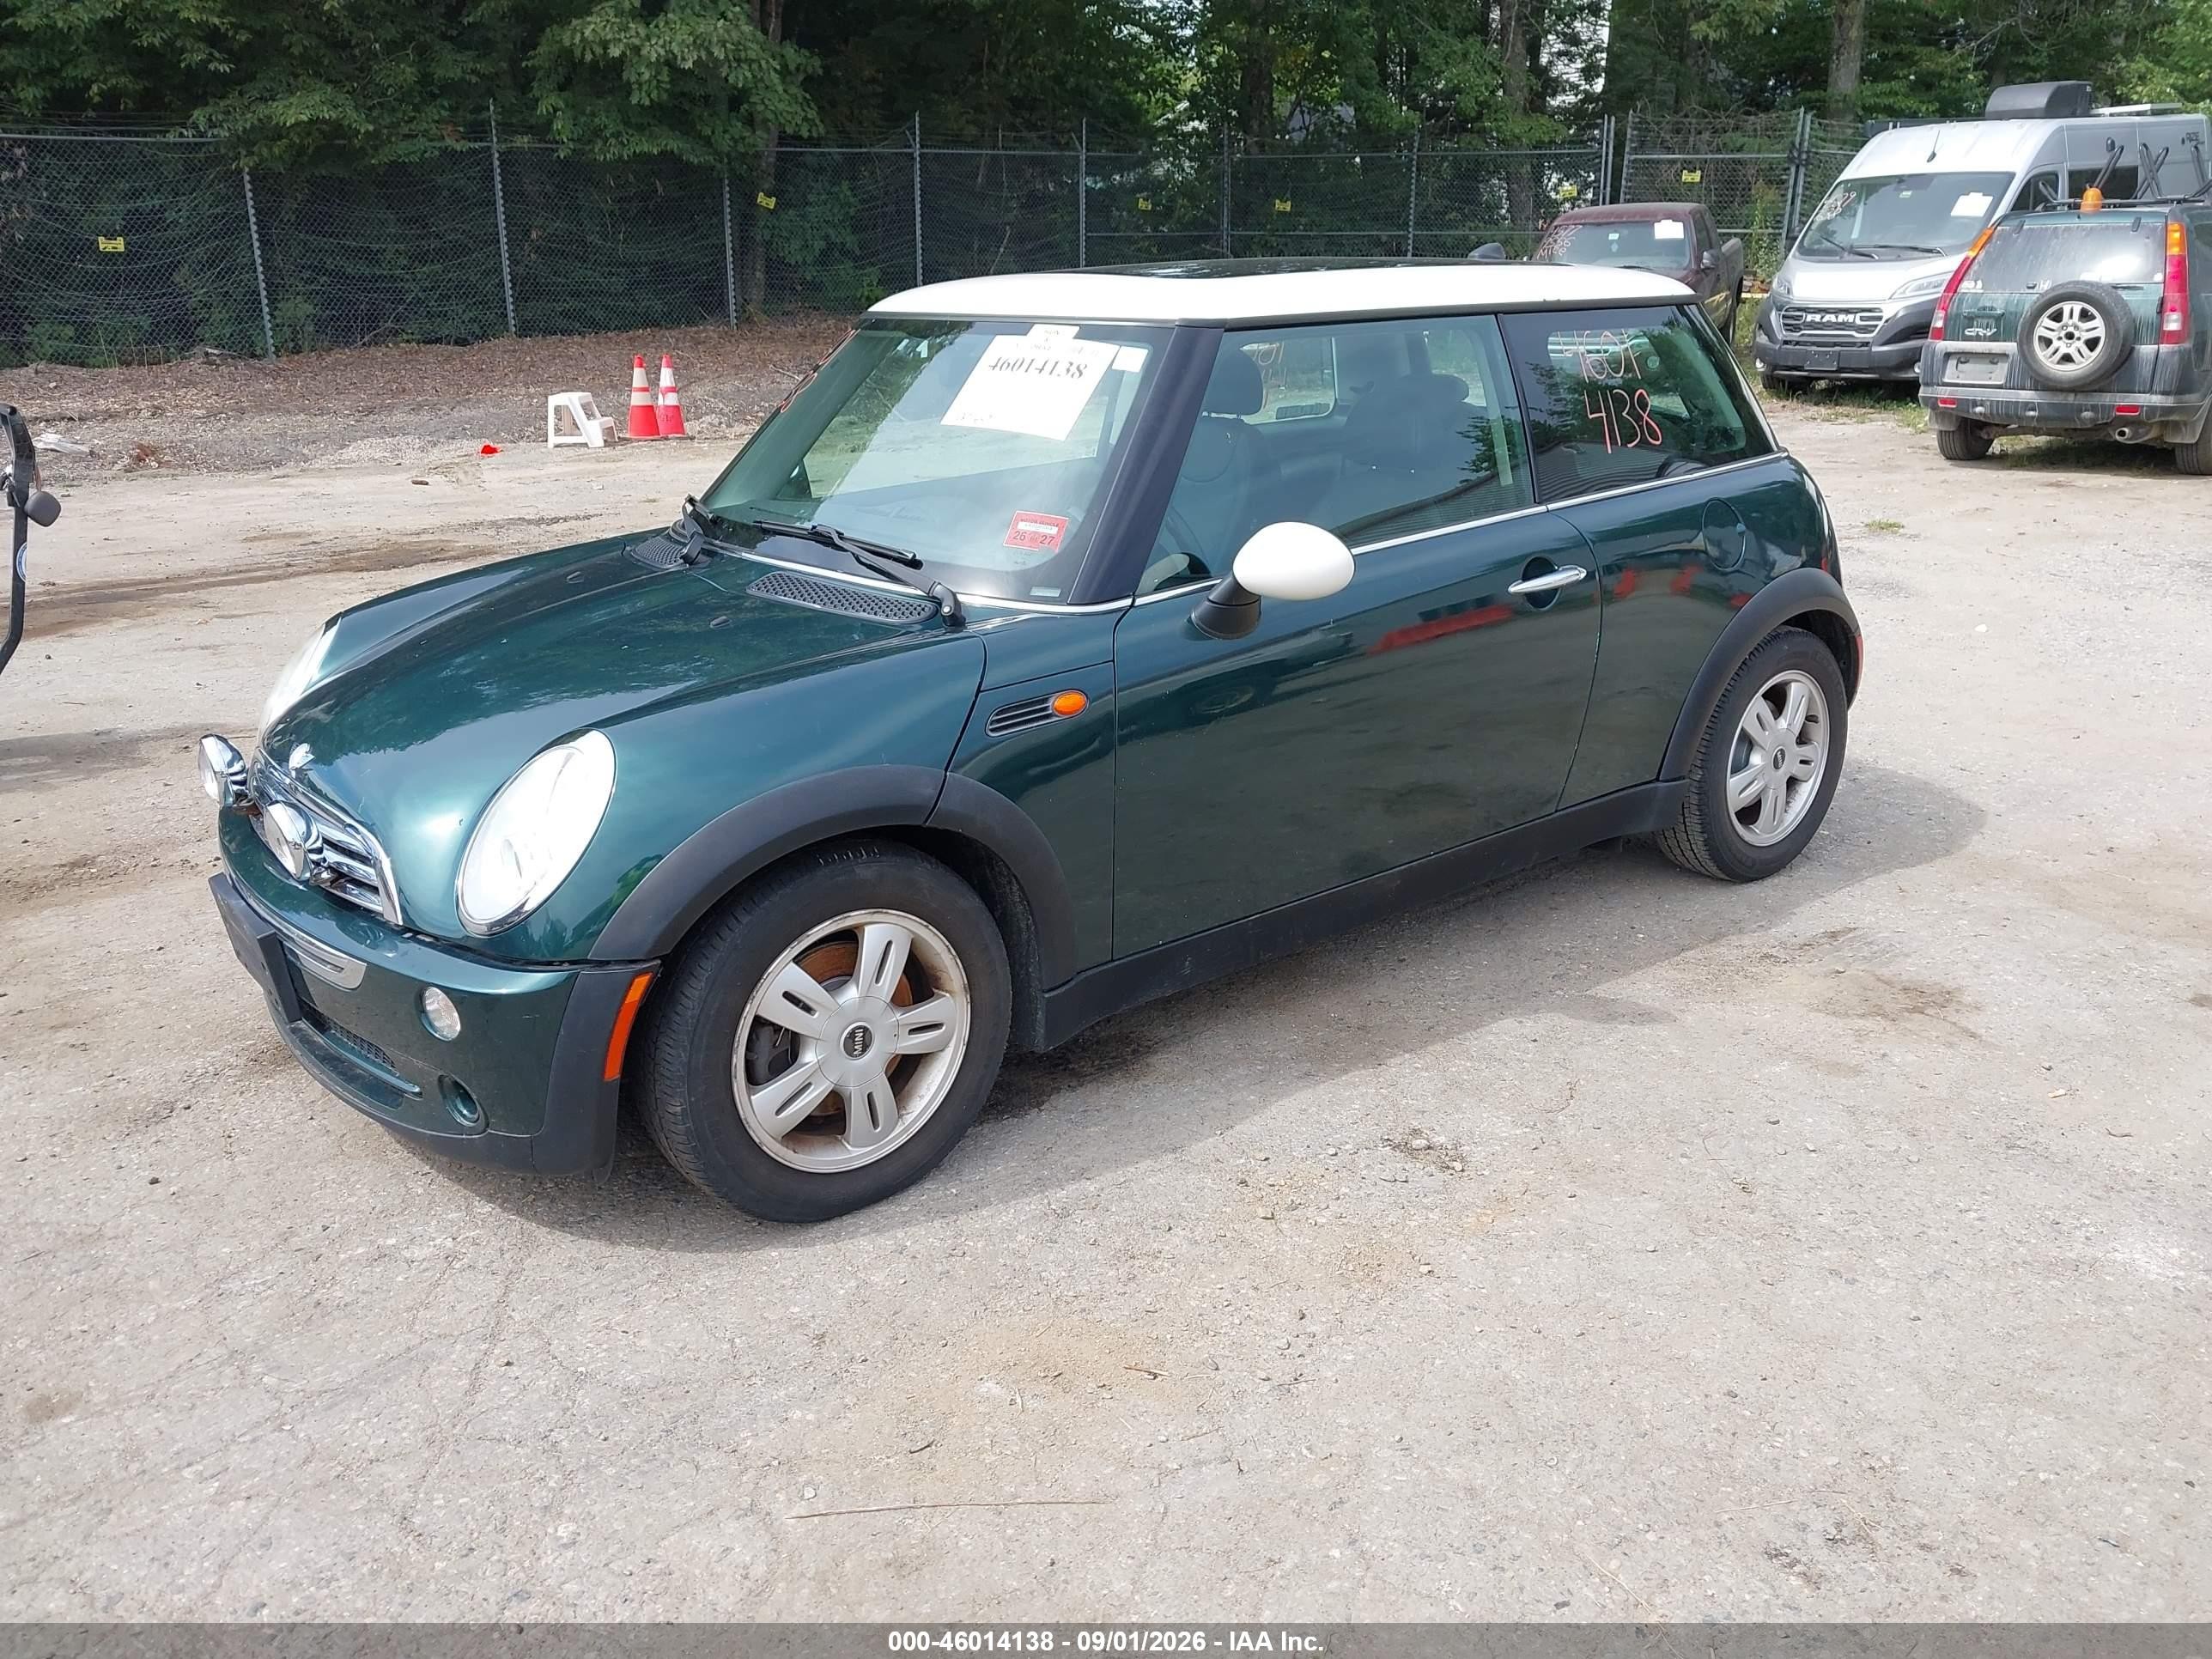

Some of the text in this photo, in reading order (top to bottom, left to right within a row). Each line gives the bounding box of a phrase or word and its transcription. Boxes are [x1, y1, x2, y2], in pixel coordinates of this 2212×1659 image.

[1806, 313, 1855, 323] RAM
[988, 356, 1088, 379] 46014138
[1584, 389, 1662, 454] 4138
[1040, 534, 1055, 545] 27
[854, 1029, 864, 1055] MINI
